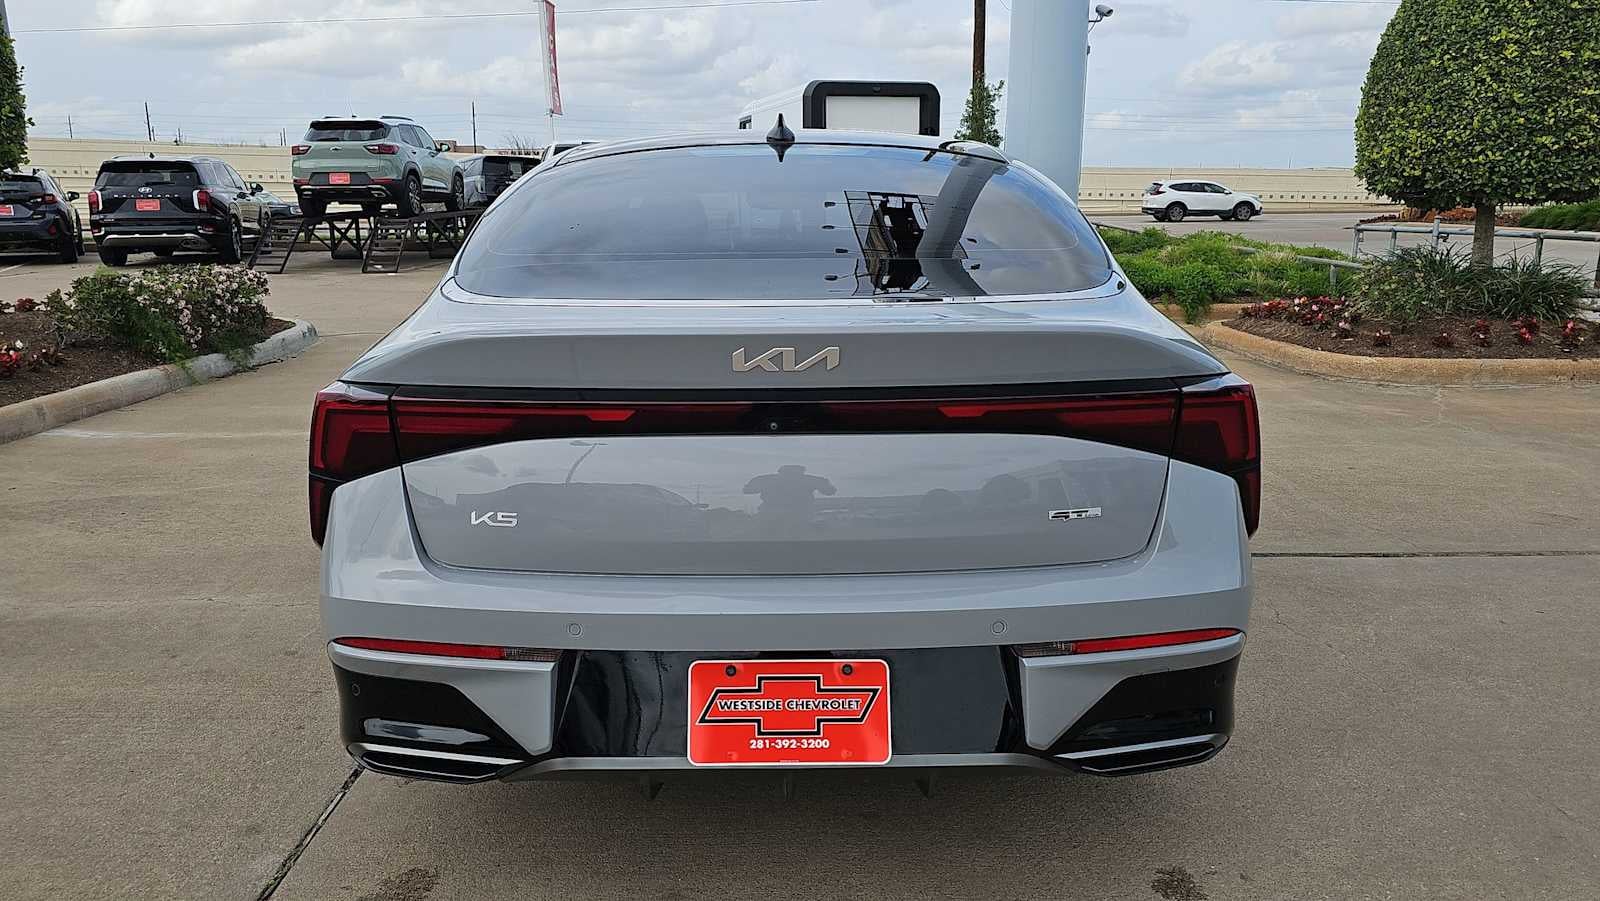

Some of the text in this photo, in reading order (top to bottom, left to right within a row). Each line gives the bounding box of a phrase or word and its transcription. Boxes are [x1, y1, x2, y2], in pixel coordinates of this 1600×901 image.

[732, 346, 840, 372] KIA
[471, 511, 518, 528] K5
[718, 699, 861, 710] WESTSIDE CHEVROLET
[749, 739, 831, 749] 281-392-3200
